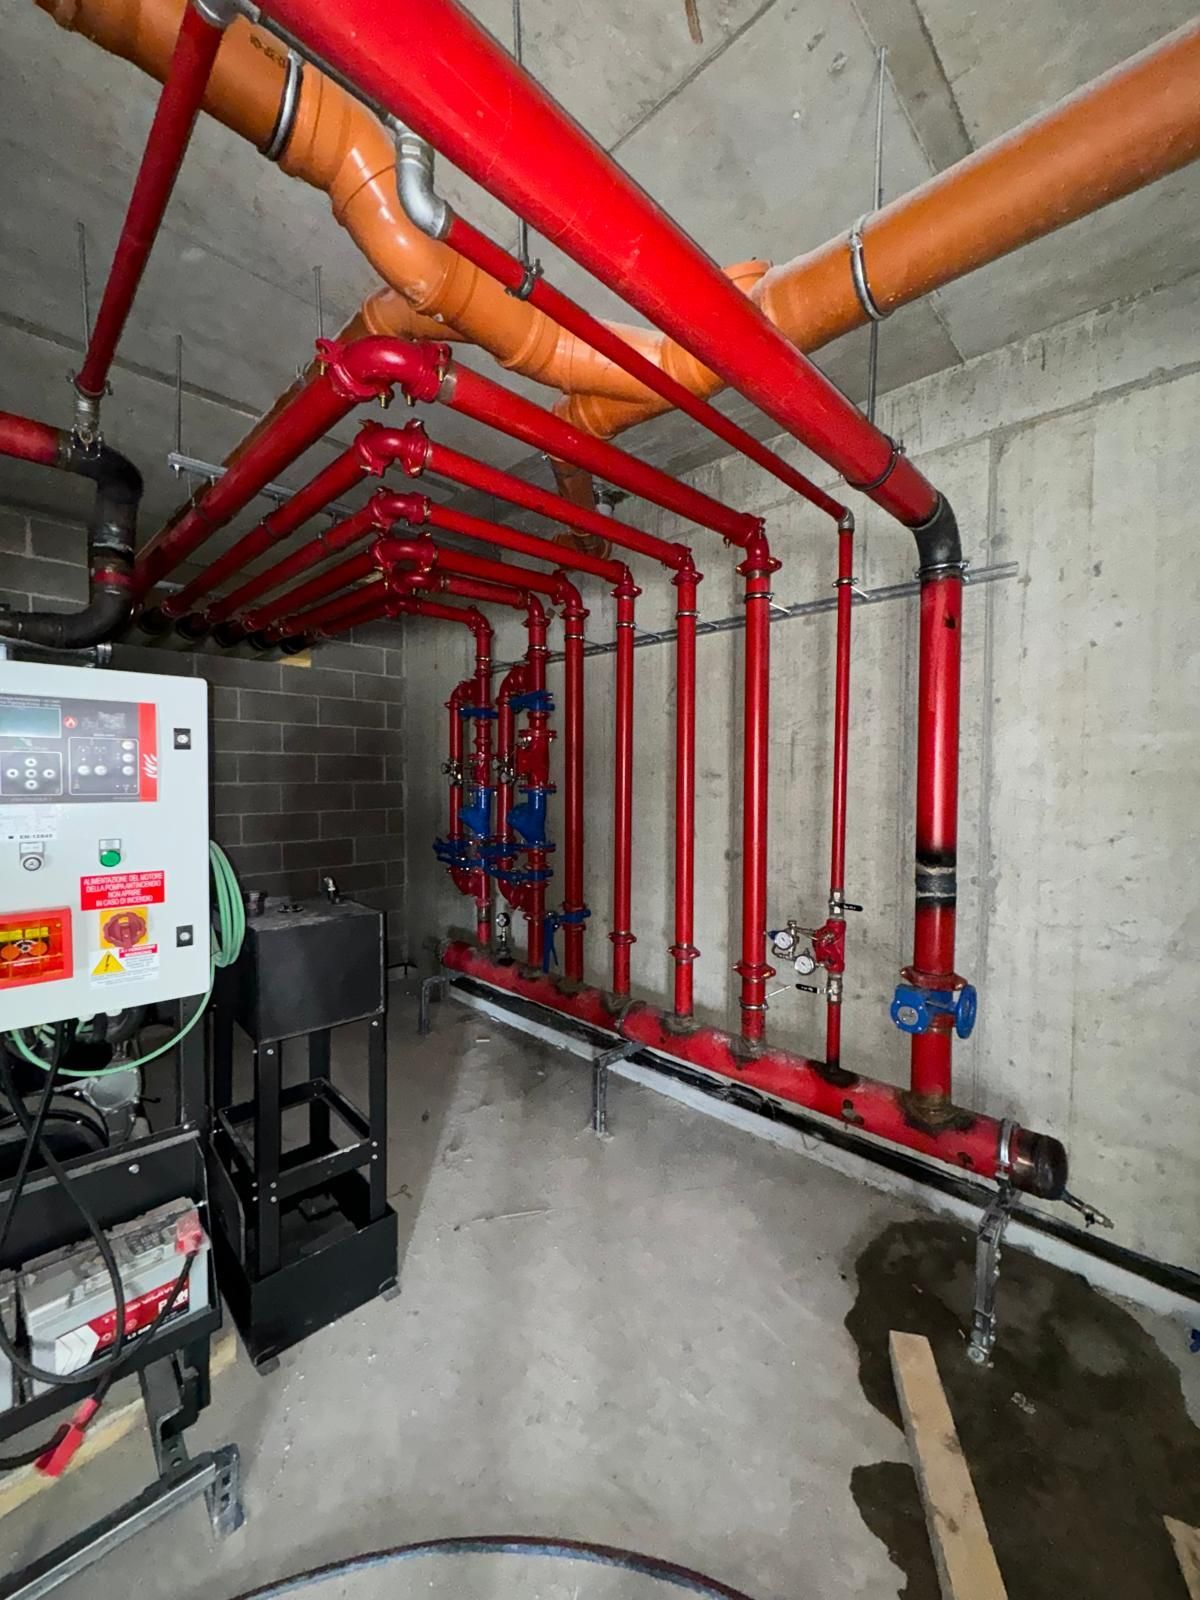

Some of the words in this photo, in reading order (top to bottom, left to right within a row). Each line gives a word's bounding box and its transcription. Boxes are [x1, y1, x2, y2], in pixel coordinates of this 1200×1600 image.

[83, 876, 128, 885] ALIMENTAZIONE
[129, 874, 139, 882] DEL
[140, 872, 163, 880] MOTORE
[86, 884, 105, 893] DELLA
[105, 882, 125, 891] POMPA
[125, 880, 162, 889] ANTINCENDIO
[107, 890, 121, 898] NON
[121, 888, 141, 897] APRIRE
[103, 898, 120, 906] CASO
[127, 895, 153, 904] INCENDIO
